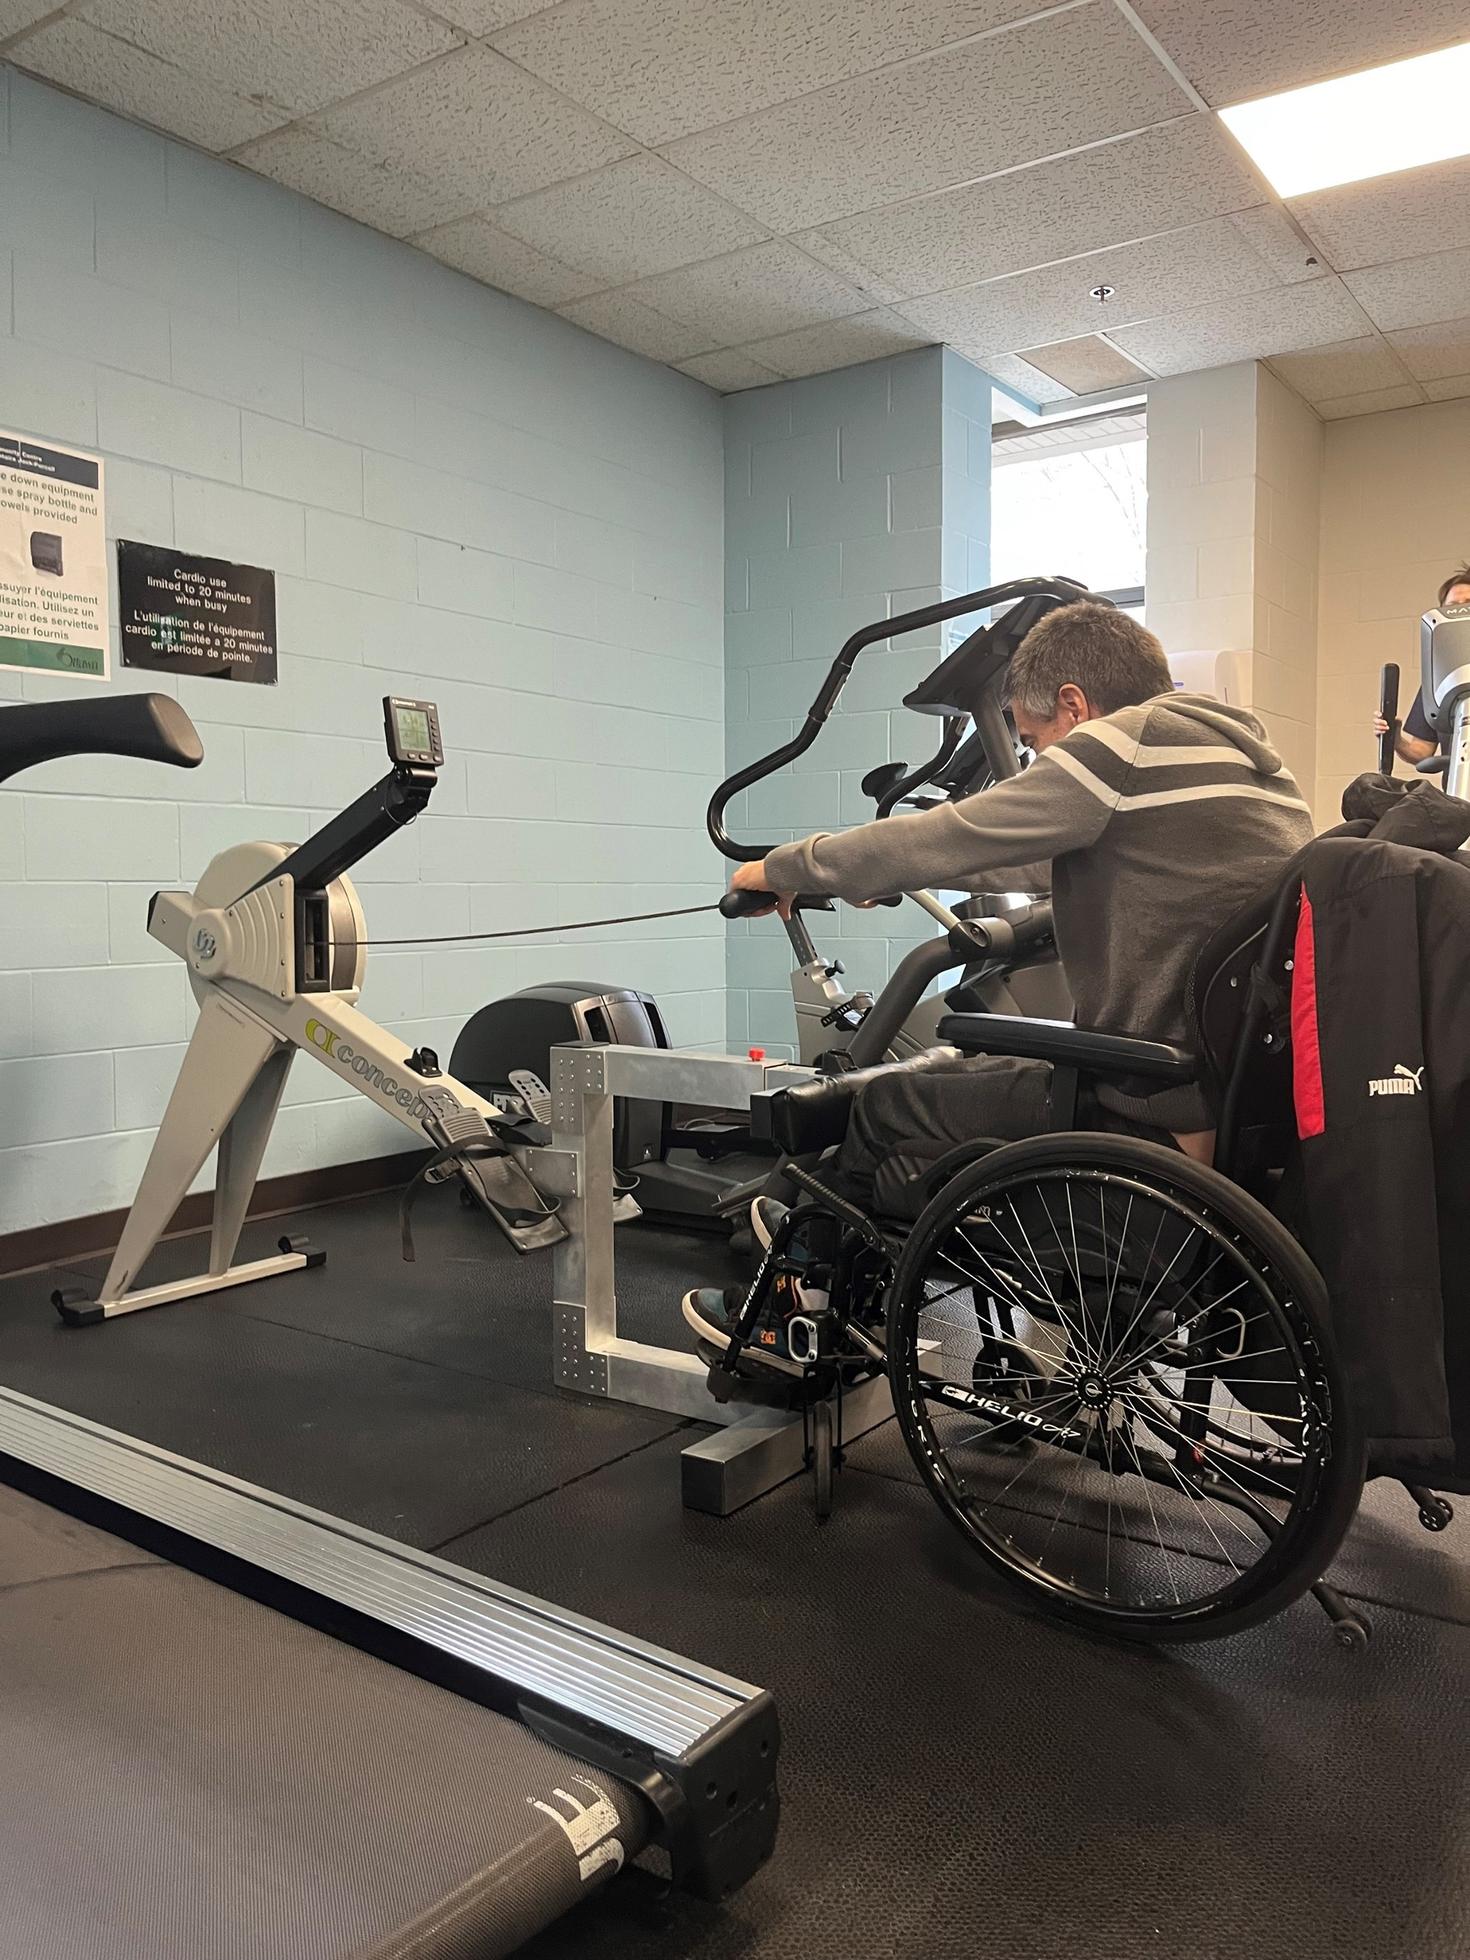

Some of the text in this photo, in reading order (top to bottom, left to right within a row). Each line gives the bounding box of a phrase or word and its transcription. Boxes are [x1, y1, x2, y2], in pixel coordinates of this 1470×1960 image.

[10, 473, 39, 488] down
[41, 482, 95, 503] equipment
[17, 489, 45, 505] spray
[48, 495, 77, 511] bottle
[79, 504, 98, 517] and
[33, 506, 78, 525] provided
[173, 568, 227, 588] Cardio use
[34, 585, 99, 605] l'équipement
[147, 575, 252, 604] limited to 20 minutes
[42, 601, 79, 616] Utilisez
[81, 609, 95, 618] un
[175, 594, 228, 613] when busy
[17, 612, 27, 621] et
[29, 612, 48, 624] des
[51, 616, 99, 631] serviettes
[134, 609, 265, 641] L'utilisation de l'équipement
[33, 626, 70, 640] fournis
[125, 624, 157, 637] cardio
[160, 628, 177, 640] est
[180, 630, 211, 645] limitée
[223, 638, 236, 649] 20
[239, 640, 273, 655] minutes
[151, 641, 253, 664] en période de pointe.
[337, 1044, 434, 1119] concep
[1368, 1078, 1415, 1097] PUMA
[967, 1393, 1044, 1427] HELIO
